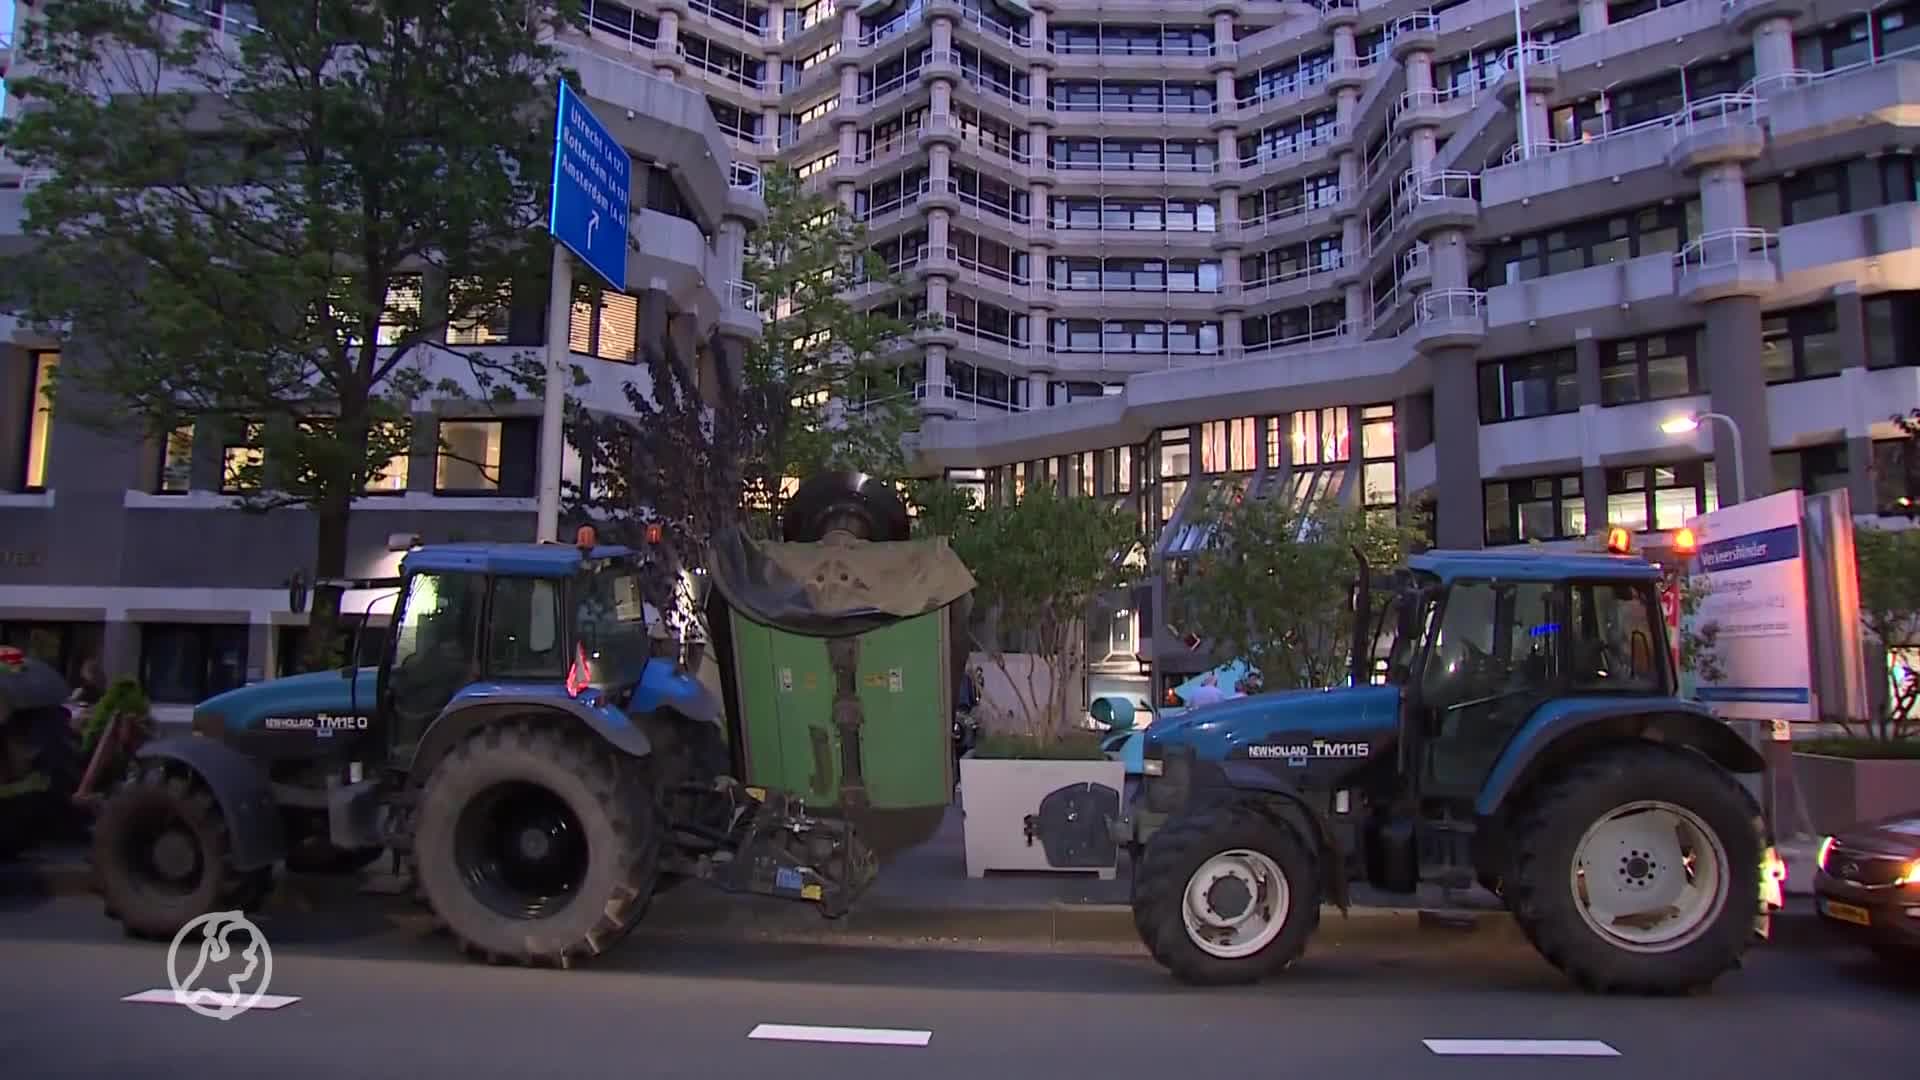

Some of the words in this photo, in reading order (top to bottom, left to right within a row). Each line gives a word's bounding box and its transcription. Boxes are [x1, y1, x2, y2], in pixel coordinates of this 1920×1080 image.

[563, 126, 607, 184] Rotterdam
[571, 104, 603, 153] Utrecht
[562, 153, 609, 211] Amsterdam
[1312, 742, 1369, 757] TM115
